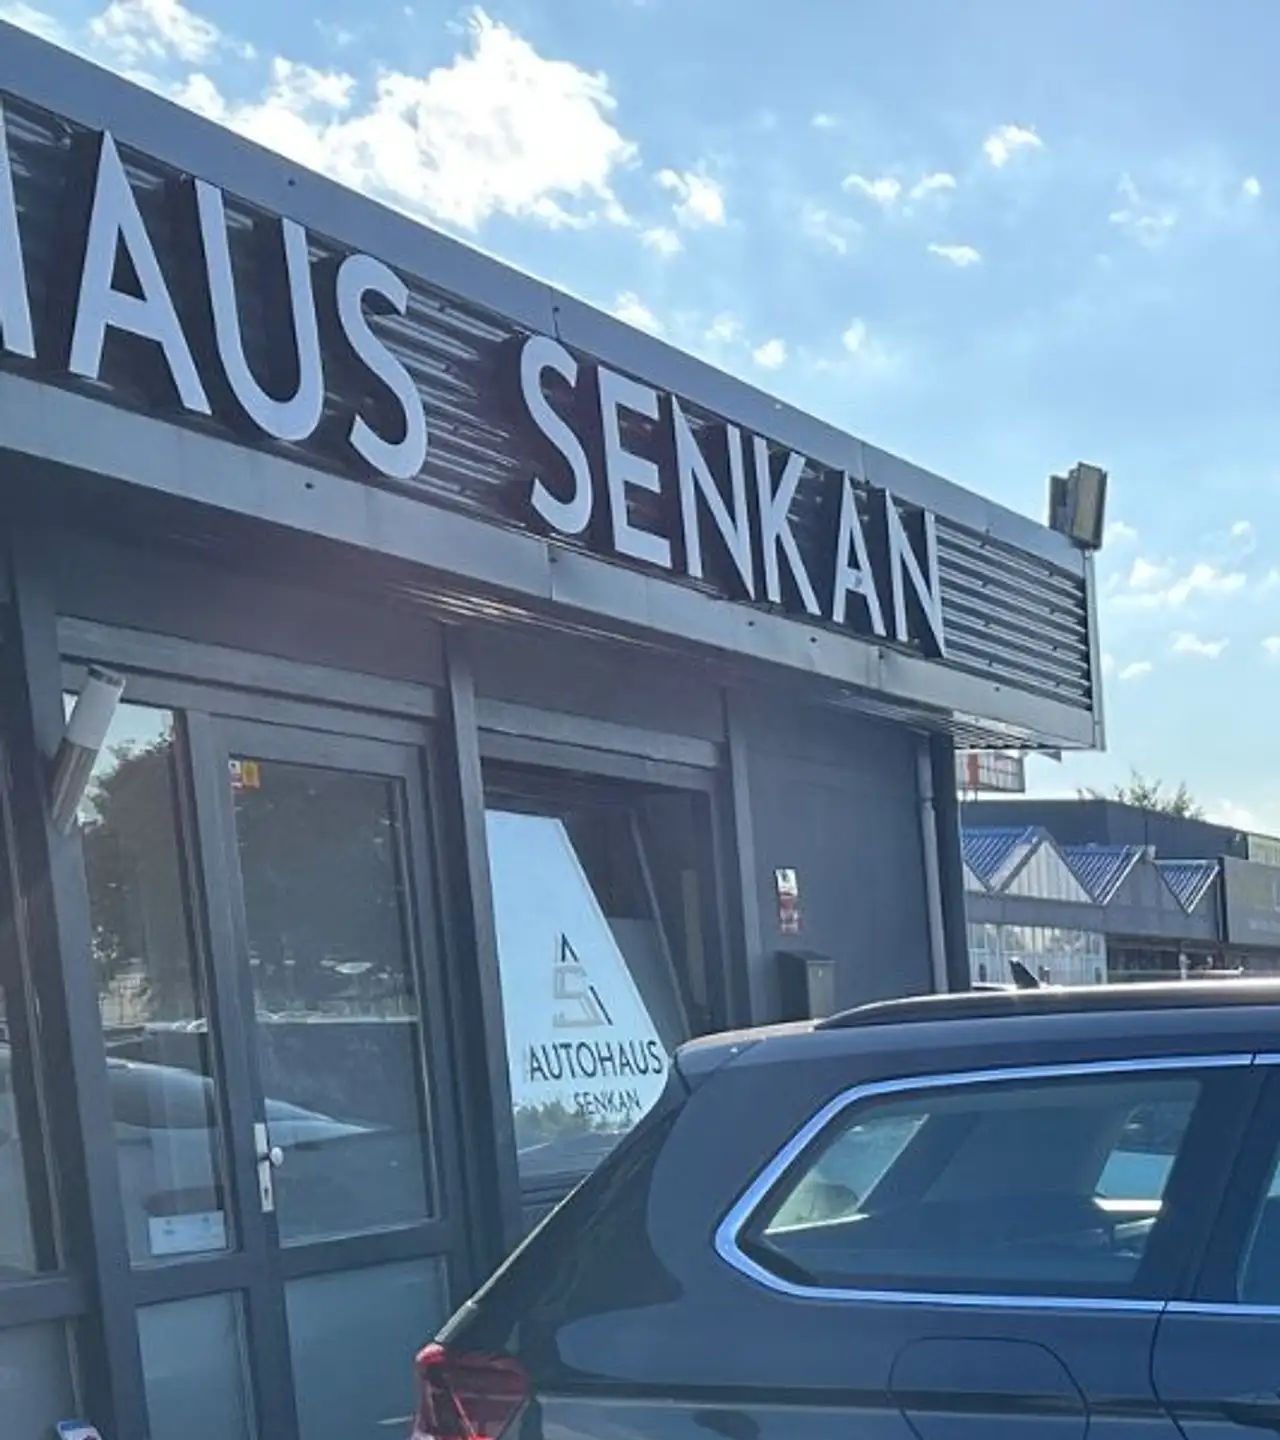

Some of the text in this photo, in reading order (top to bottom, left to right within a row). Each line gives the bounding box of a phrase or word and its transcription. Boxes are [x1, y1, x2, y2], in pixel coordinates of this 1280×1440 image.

[520, 336, 945, 657] SENKAN
[530, 1040, 663, 1082] AUTOHAUS
[573, 1088, 642, 1116] SENKAN
